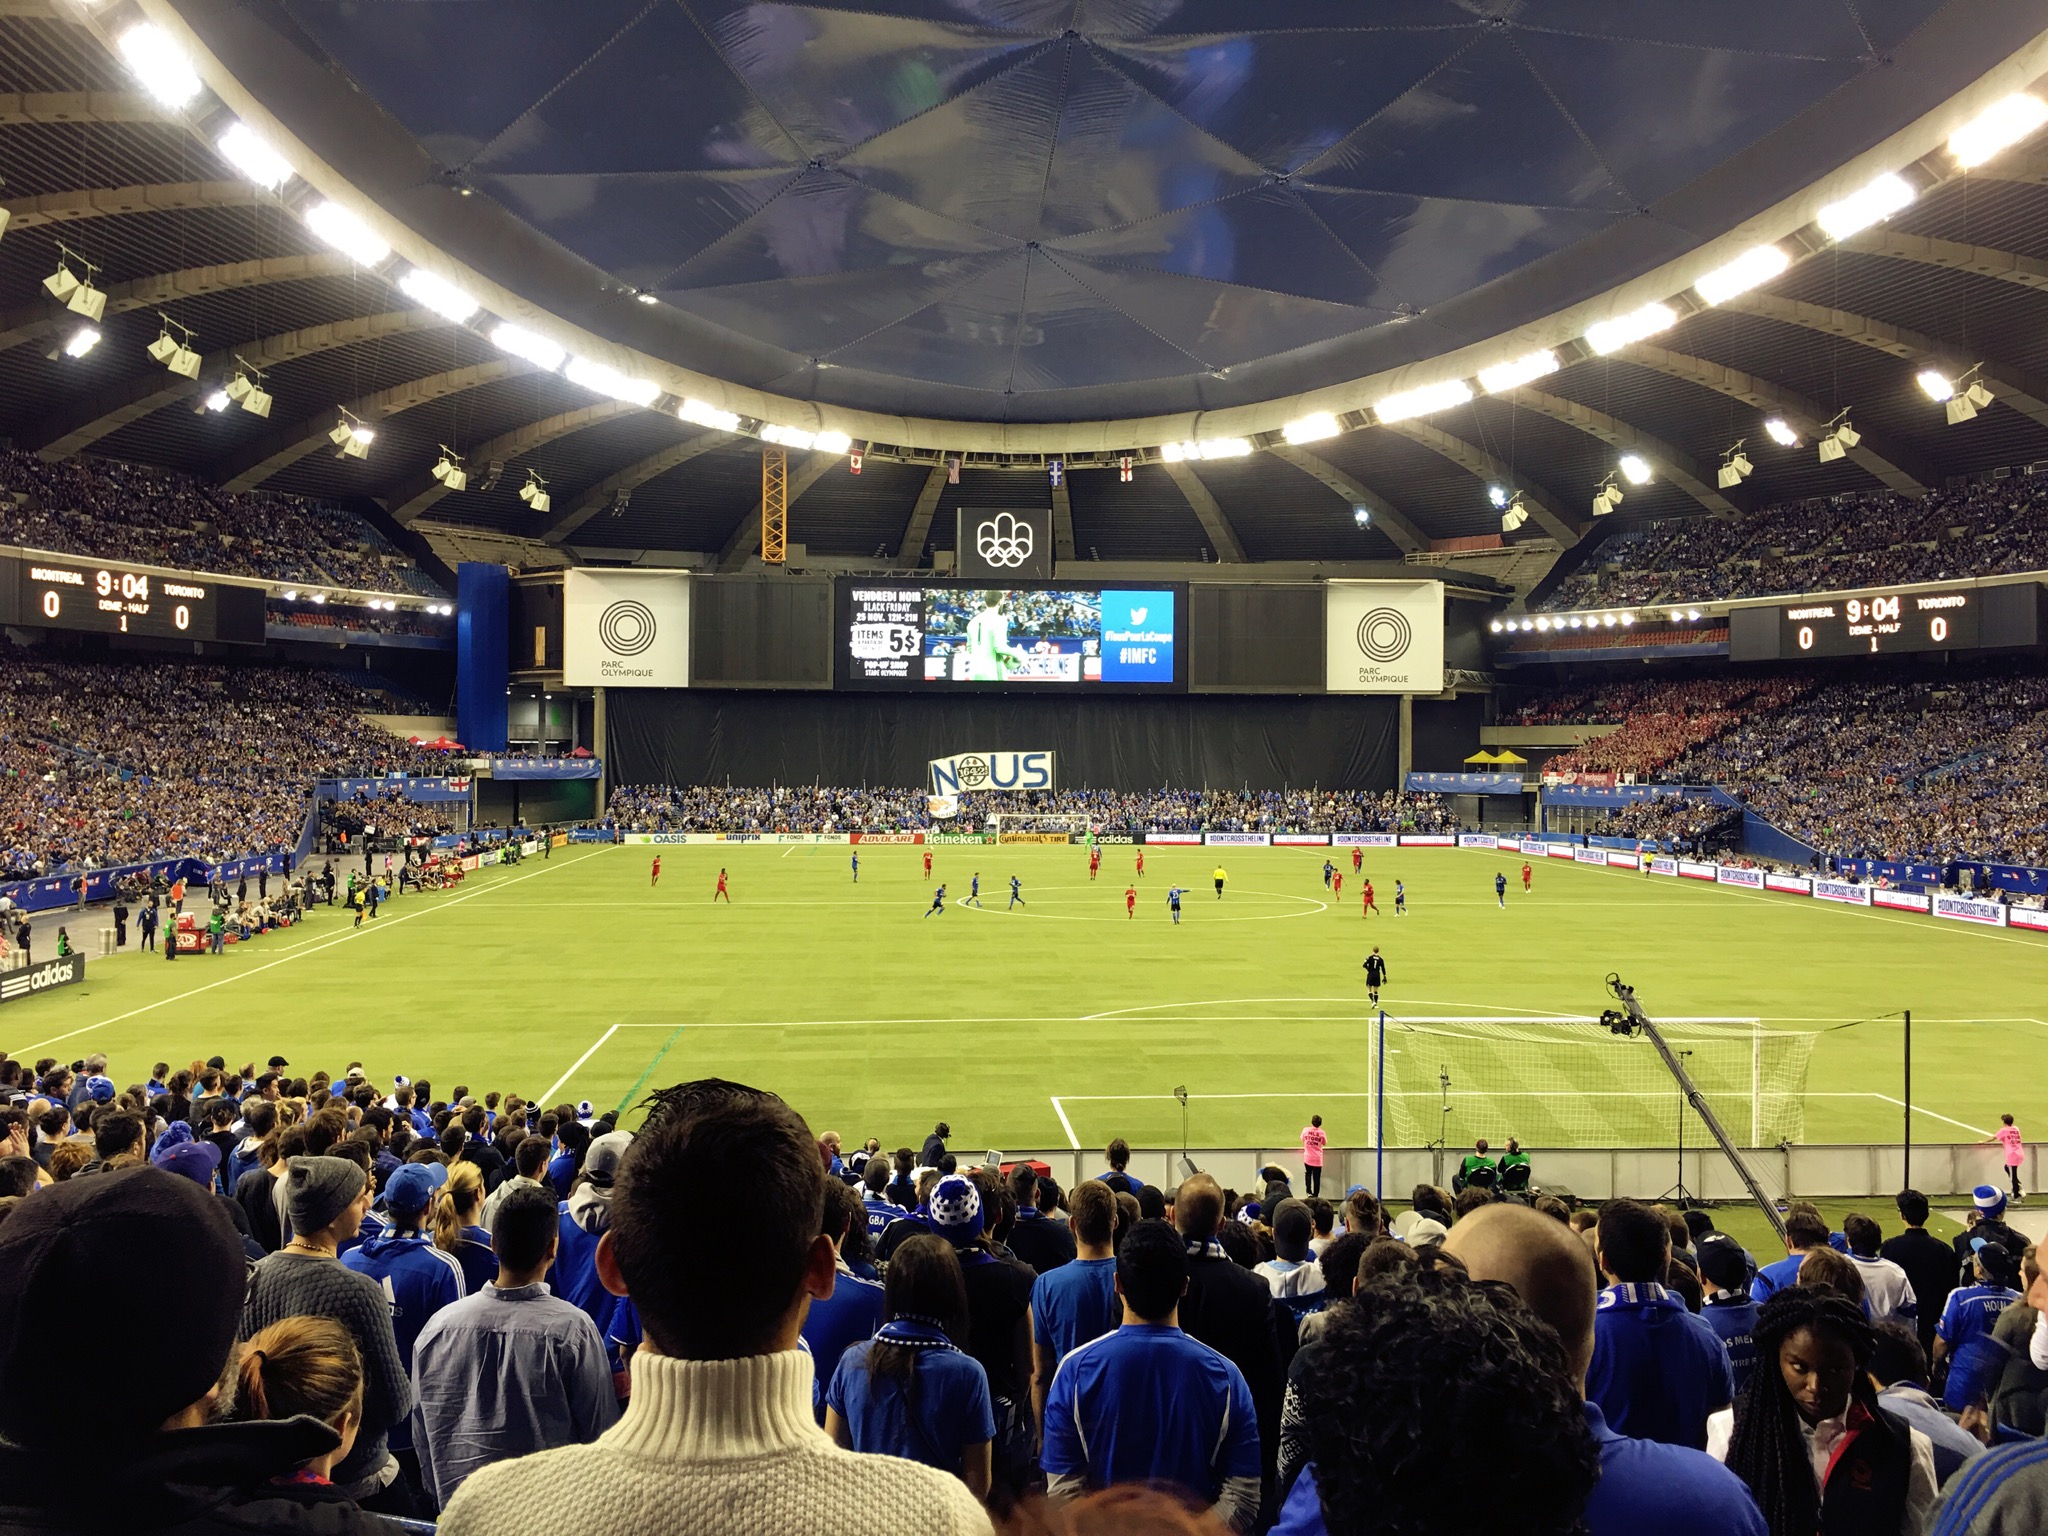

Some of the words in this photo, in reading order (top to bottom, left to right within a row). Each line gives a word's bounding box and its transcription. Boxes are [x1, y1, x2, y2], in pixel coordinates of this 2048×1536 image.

[31, 568, 85, 585] MONTREAL
[96, 571, 149, 600] 9:04
[164, 584, 205, 599] TORONTO
[852, 591, 897, 602] VENDREDI
[899, 591, 922, 602] NOIR
[44, 591, 59, 618] 0
[128, 603, 149, 615] HALF
[863, 602, 886, 612] BLACK
[886, 602, 911, 612] FRIDAY
[1917, 596, 1966, 610] TORONTO
[1788, 607, 1835, 619] MONTREAL
[1847, 596, 1900, 623] 9:04
[119, 615, 128, 632] 1
[175, 606, 189, 630] 0
[867, 613, 886, 622] NOV.
[888, 613, 919, 622] 12H-21H
[1879, 623, 1901, 633] HALF
[1931, 616, 1947, 641] 0
[858, 630, 884, 639] ITEMS
[890, 629, 915, 652] 5$
[1799, 626, 1813, 650] 0
[1870, 636, 1878, 652] 1
[1120, 647, 1157, 664] #IMFC
[601, 660, 624, 668] PARC
[601, 668, 653, 677] OLYMPIQUE
[1359, 667, 1380, 675] PARC
[1359, 675, 1408, 683] OLYMPIQUE
[653, 834, 687, 844] OASIS
[726, 833, 761, 844] uniprix
[859, 834, 915, 844] ADVOCARE
[924, 833, 983, 844] Heineken
[1097, 834, 1133, 844] adidas
[1209, 834, 1265, 842] #DONTCROSSTHELINE
[1337, 835, 1392, 844] #DONTCROSSTHELINE
[1817, 883, 1867, 900] #DONTCROSSTHELINE
[1938, 899, 2000, 920] #DONTCROSSTHELINE
[31, 962, 73, 990] adidas
